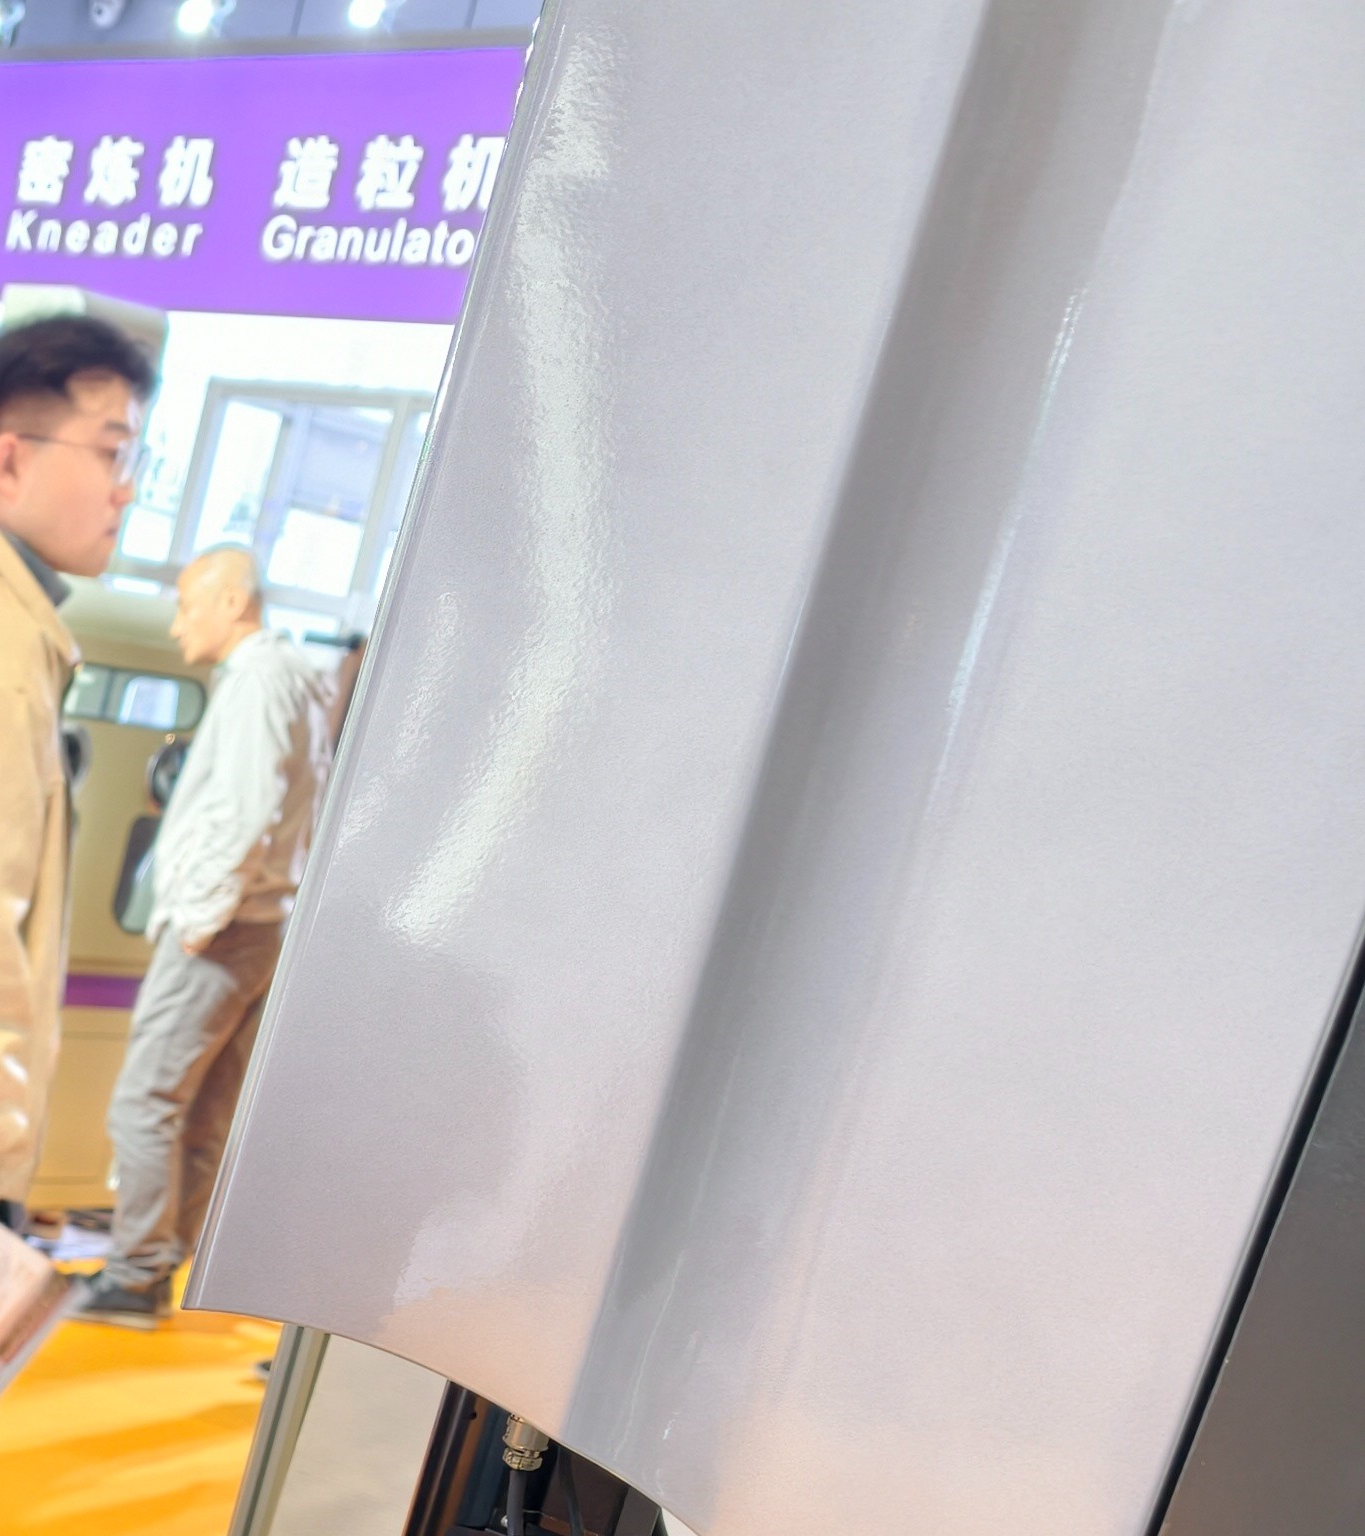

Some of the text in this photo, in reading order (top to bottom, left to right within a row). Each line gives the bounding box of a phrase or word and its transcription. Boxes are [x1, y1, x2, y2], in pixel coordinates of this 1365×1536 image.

[16, 133, 506, 211] 密炼机 造粒机
[4, 210, 203, 257] Kneader
